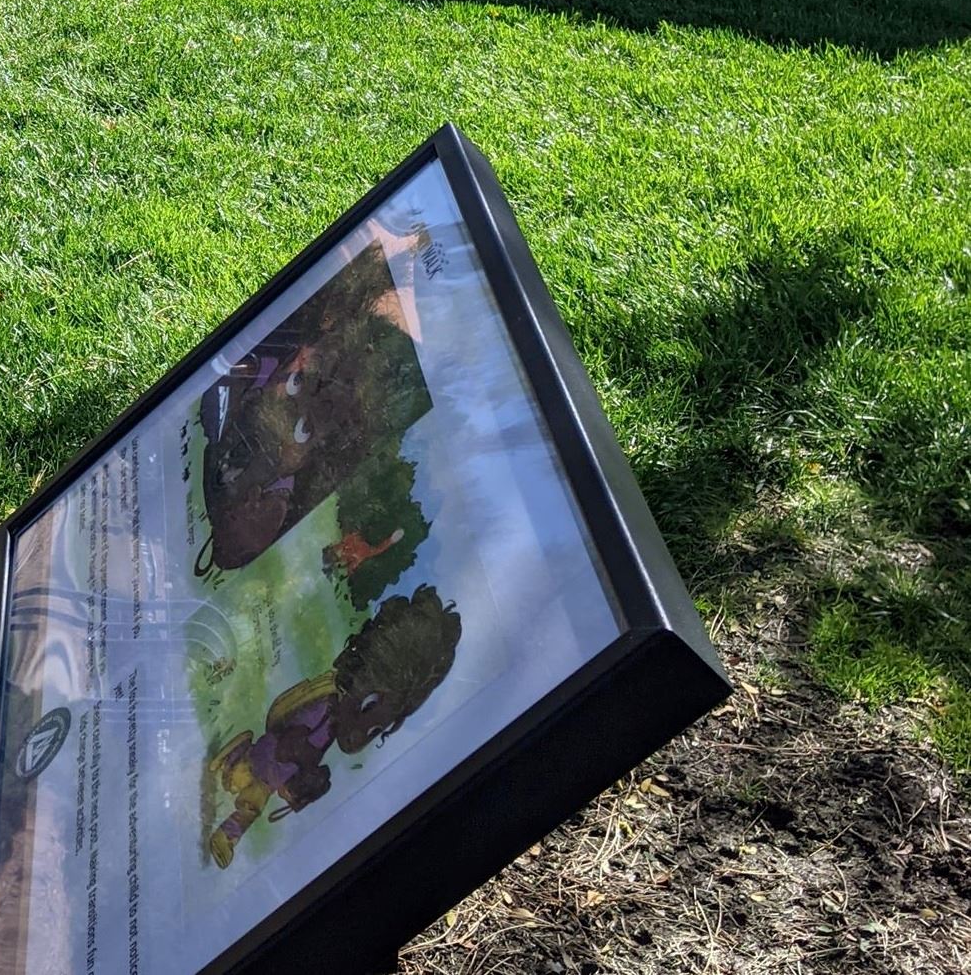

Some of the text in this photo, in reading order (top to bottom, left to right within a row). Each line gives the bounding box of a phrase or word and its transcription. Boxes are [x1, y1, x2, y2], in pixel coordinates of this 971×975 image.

[129, 687, 137, 705] fox
[127, 713, 136, 743] pretty
[90, 728, 101, 769] carefully
[127, 742, 137, 776] sneaky
[77, 763, 86, 806] between
[92, 779, 100, 798] the
[127, 811, 138, 876] adventuring
[87, 850, 98, 890] Making
[129, 874, 139, 903] child
[87, 888, 97, 949] transitions
[129, 902, 138, 917] to
[129, 918, 138, 941] not
[87, 948, 97, 971] fun
